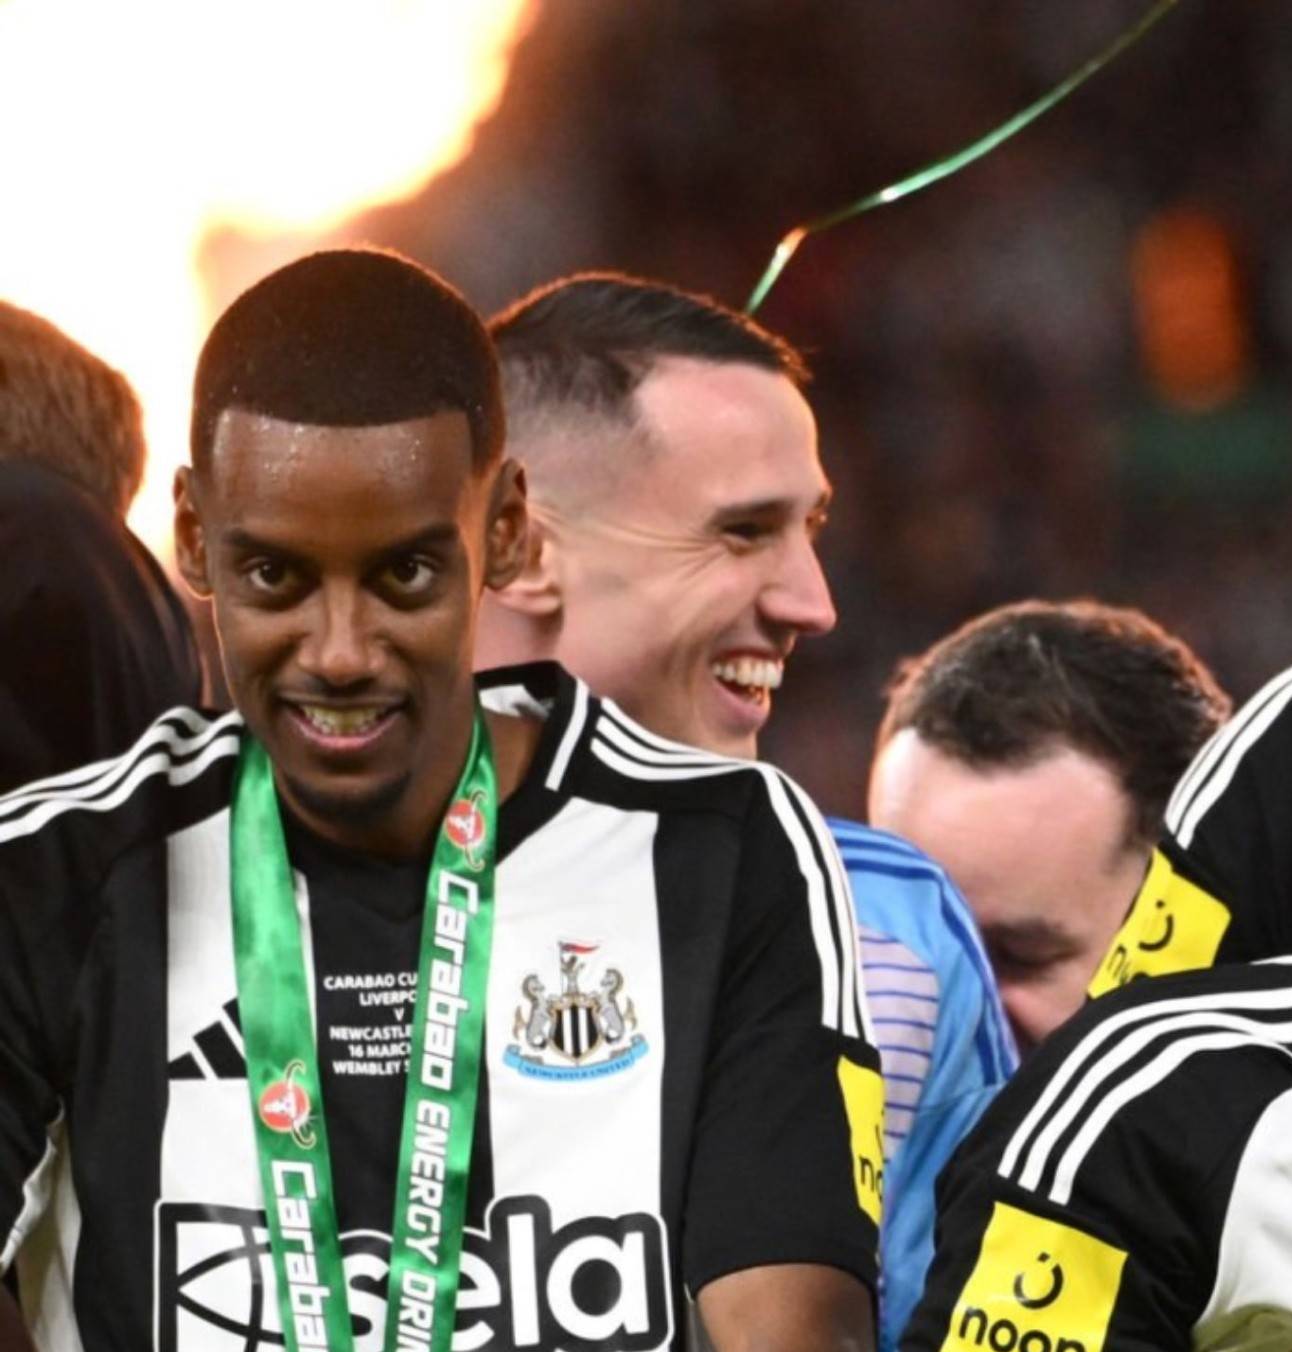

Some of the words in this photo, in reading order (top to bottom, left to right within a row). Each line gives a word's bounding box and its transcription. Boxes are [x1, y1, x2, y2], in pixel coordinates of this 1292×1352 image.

[323, 972, 395, 990] CARABAO
[397, 971, 418, 987] CU
[420, 869, 479, 1091] Carabao
[359, 990, 417, 1006] LIVERPO
[393, 1007, 405, 1021] V
[348, 1043, 364, 1058] 16
[332, 1060, 401, 1076] WEMBLEY
[404, 1098, 452, 1265] ENERGY
